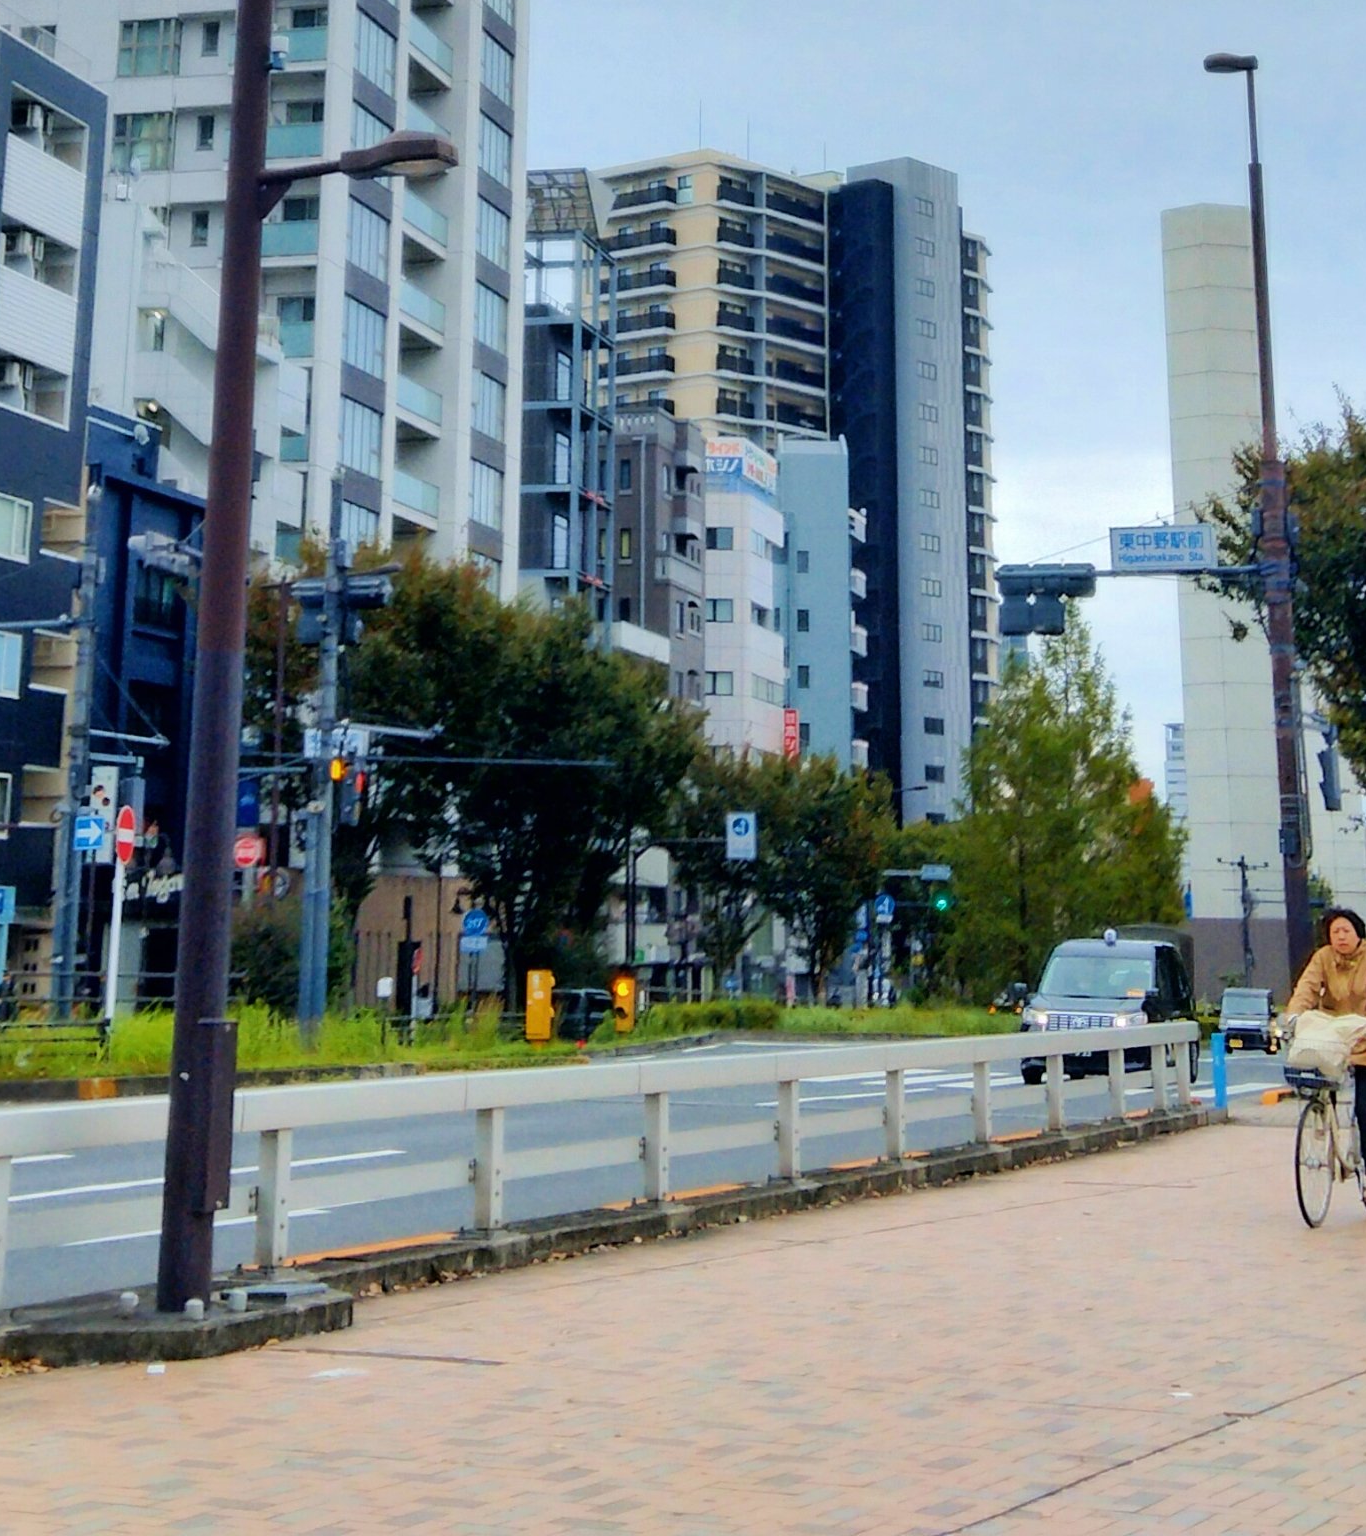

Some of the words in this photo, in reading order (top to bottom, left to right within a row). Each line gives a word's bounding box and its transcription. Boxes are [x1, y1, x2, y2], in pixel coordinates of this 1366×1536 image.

[1118, 531, 1204, 550] 東中野駅前
